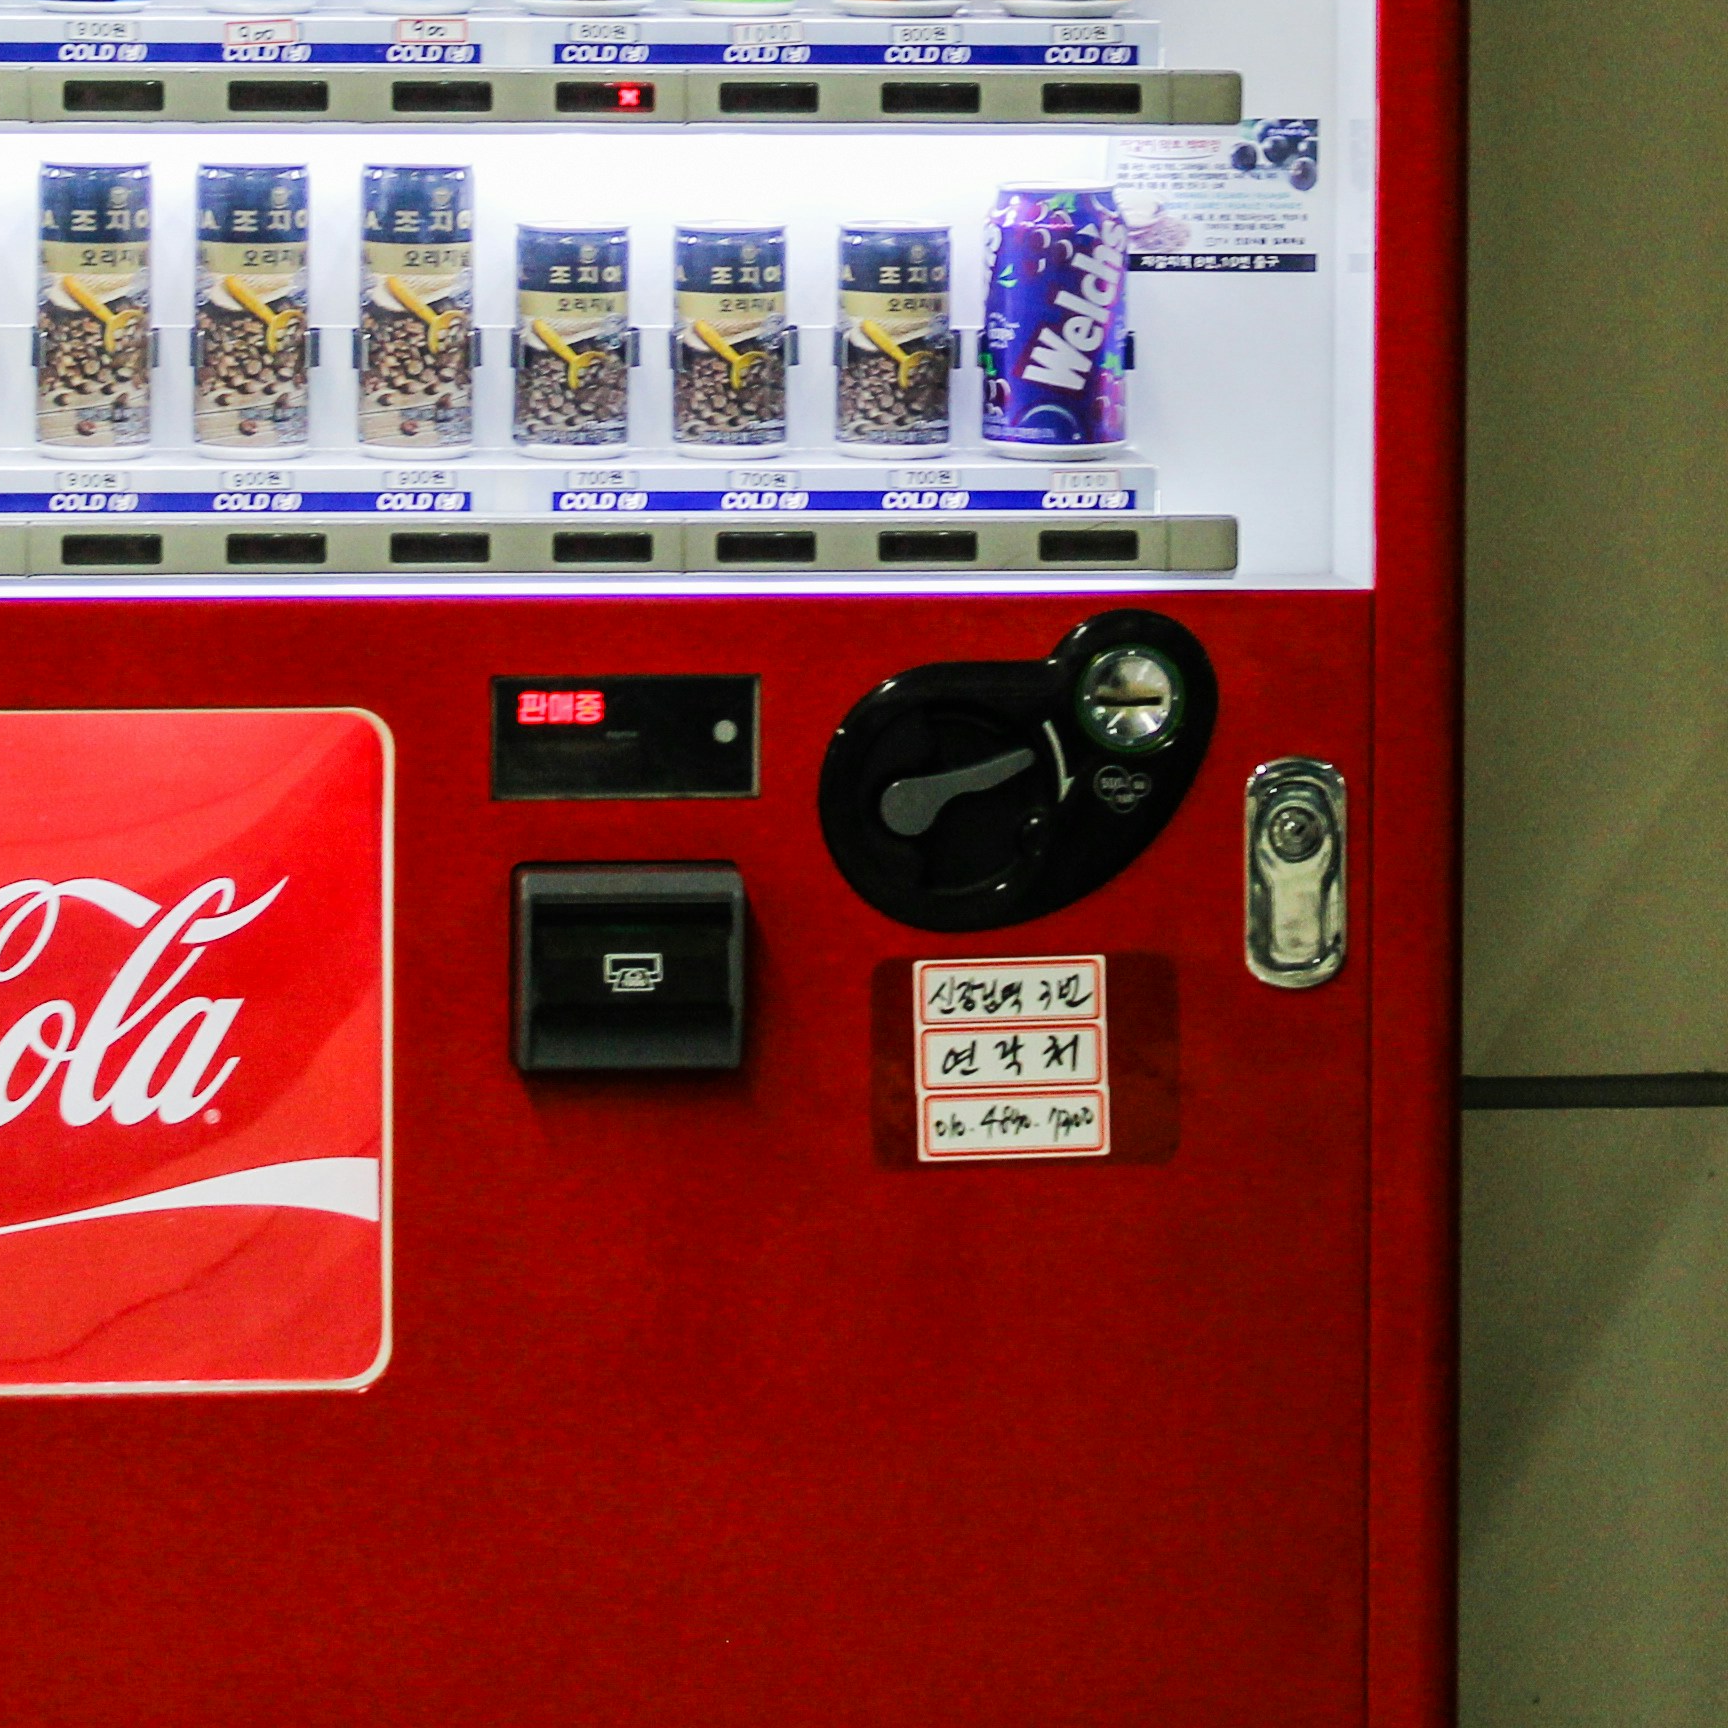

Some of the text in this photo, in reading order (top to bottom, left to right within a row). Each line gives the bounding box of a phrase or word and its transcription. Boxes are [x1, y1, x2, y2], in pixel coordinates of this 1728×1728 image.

[57, 42, 114, 64] COLD
[221, 42, 278, 64] COLD
[384, 42, 441, 64] COLD
[559, 43, 616, 66] COLD
[721, 43, 778, 66] COLD
[881, 44, 938, 66] COLD
[1041, 44, 1098, 66] COLD
[1022, 220, 1128, 391] Welch's
[48, 491, 105, 514] COLD
[212, 491, 269, 514] COLD
[375, 491, 432, 514] COLD
[558, 490, 615, 512] COLD
[719, 490, 776, 512] COLD
[880, 490, 937, 512] COLD
[517, 690, 605, 725] 판매중
